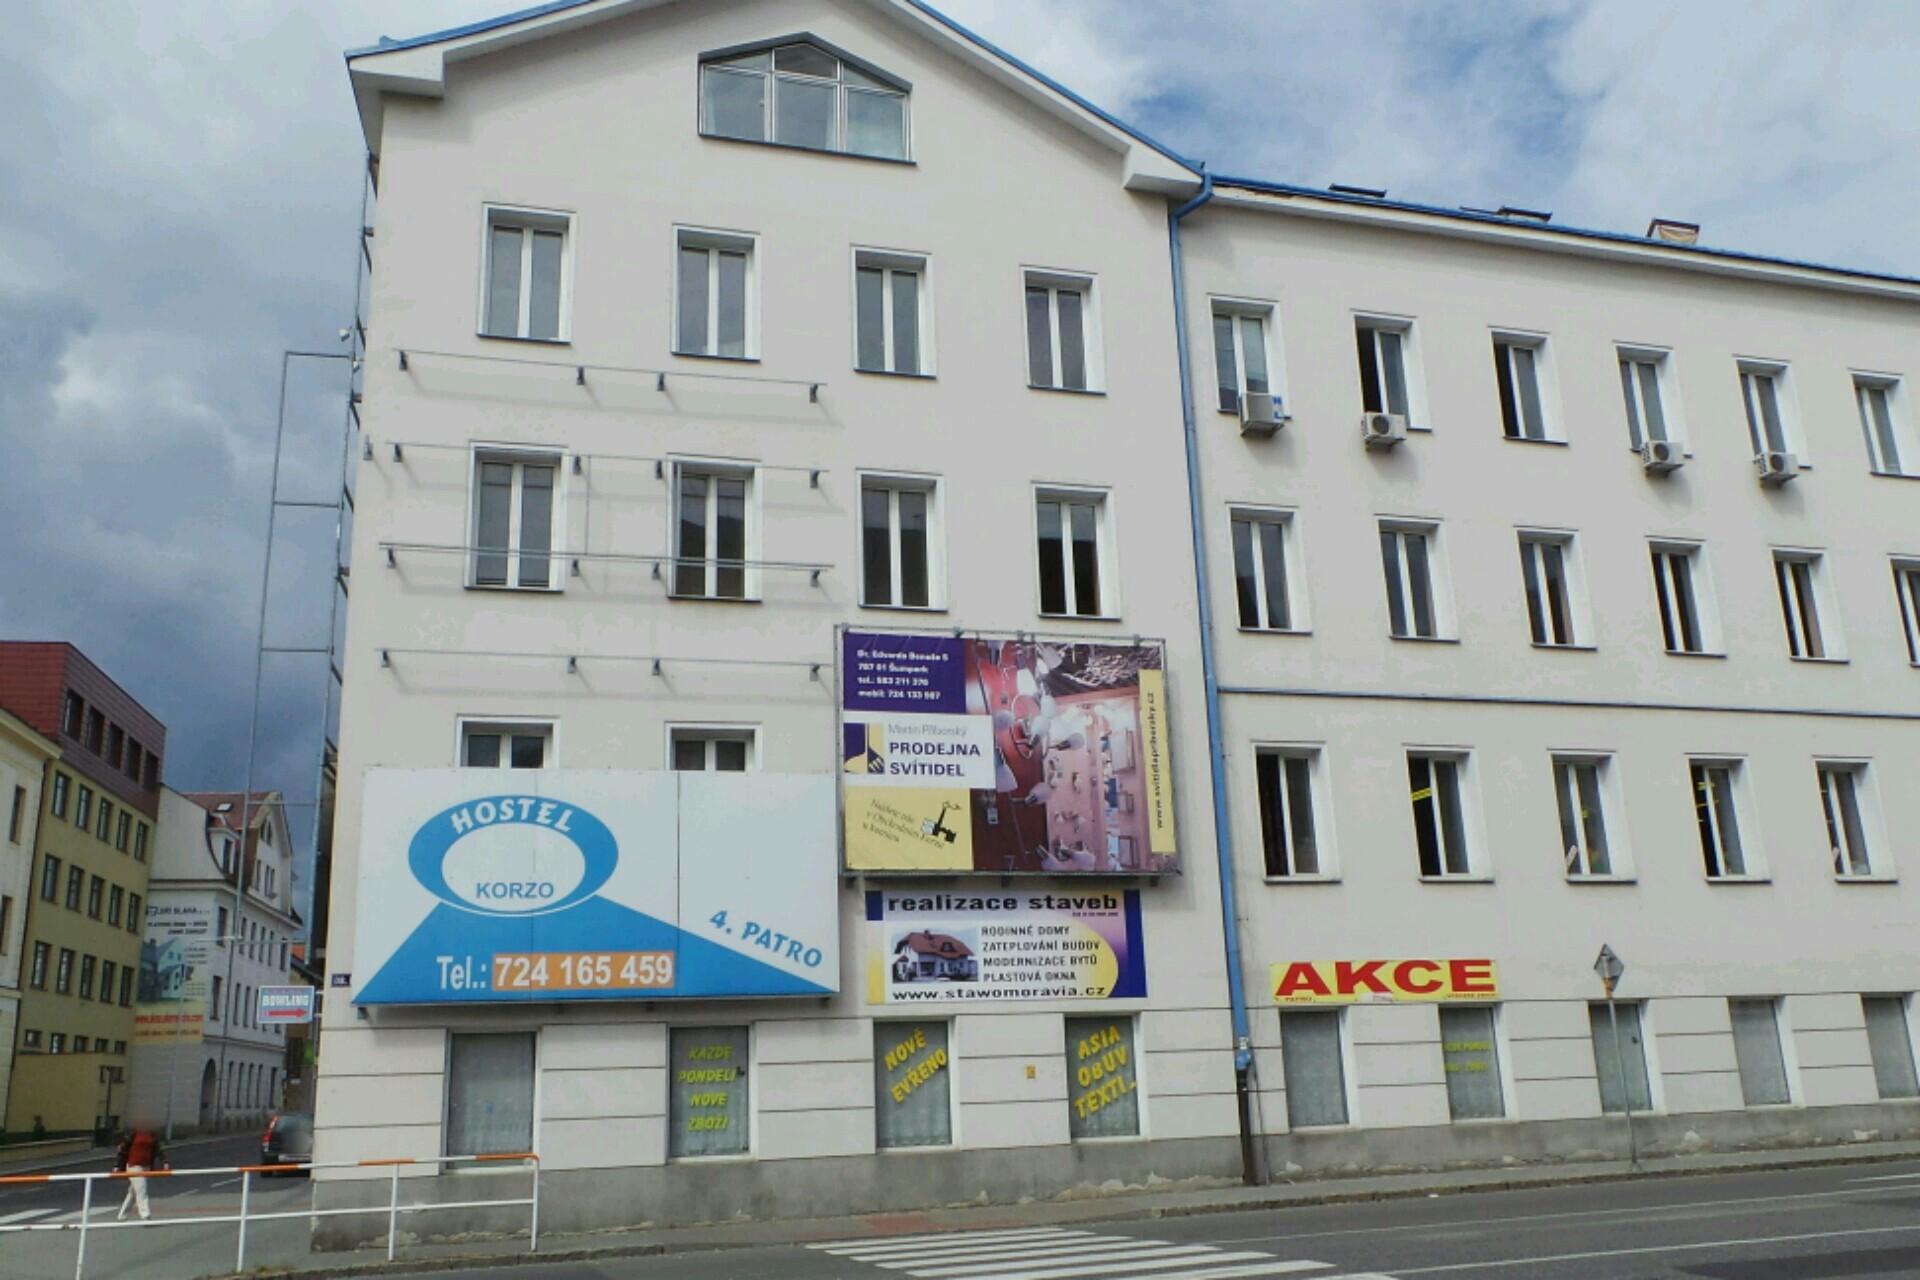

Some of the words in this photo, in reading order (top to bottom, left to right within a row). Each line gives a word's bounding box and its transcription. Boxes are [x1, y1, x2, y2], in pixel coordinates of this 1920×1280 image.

[895, 677, 910, 685] 211
[888, 723, 920, 735] Martin
[889, 742, 980, 756] PRODEJNA
[890, 760, 965, 776] SVÍTIDEL
[450, 798, 574, 834] HOSTEL
[476, 882, 554, 899] KORZO
[888, 894, 1018, 911] realizace
[1029, 894, 1118, 910] staveb
[981, 925, 1033, 936] RODINNÉ
[1038, 926, 1070, 935] DOMY
[709, 910, 732, 934] 4.
[741, 921, 823, 968] PATRO
[983, 940, 1058, 952] ZATEPLOVÁNÍ
[1062, 941, 1100, 951] BUDOV
[983, 956, 1065, 967] MODERNIZACE
[436, 955, 486, 990] Tel.:
[495, 956, 548, 987] 724
[560, 956, 611, 986] 165
[620, 955, 673, 985] 459
[984, 971, 1041, 983] PLASTOVÁ
[1045, 971, 1077, 981] OKNA
[1275, 959, 1496, 996] AKCE
[892, 985, 1105, 1000] www.stawomoravia.cz
[262, 995, 309, 1007] BOWLING
[1078, 1024, 1120, 1059] ASIA
[1078, 1044, 1127, 1087] OBUV
